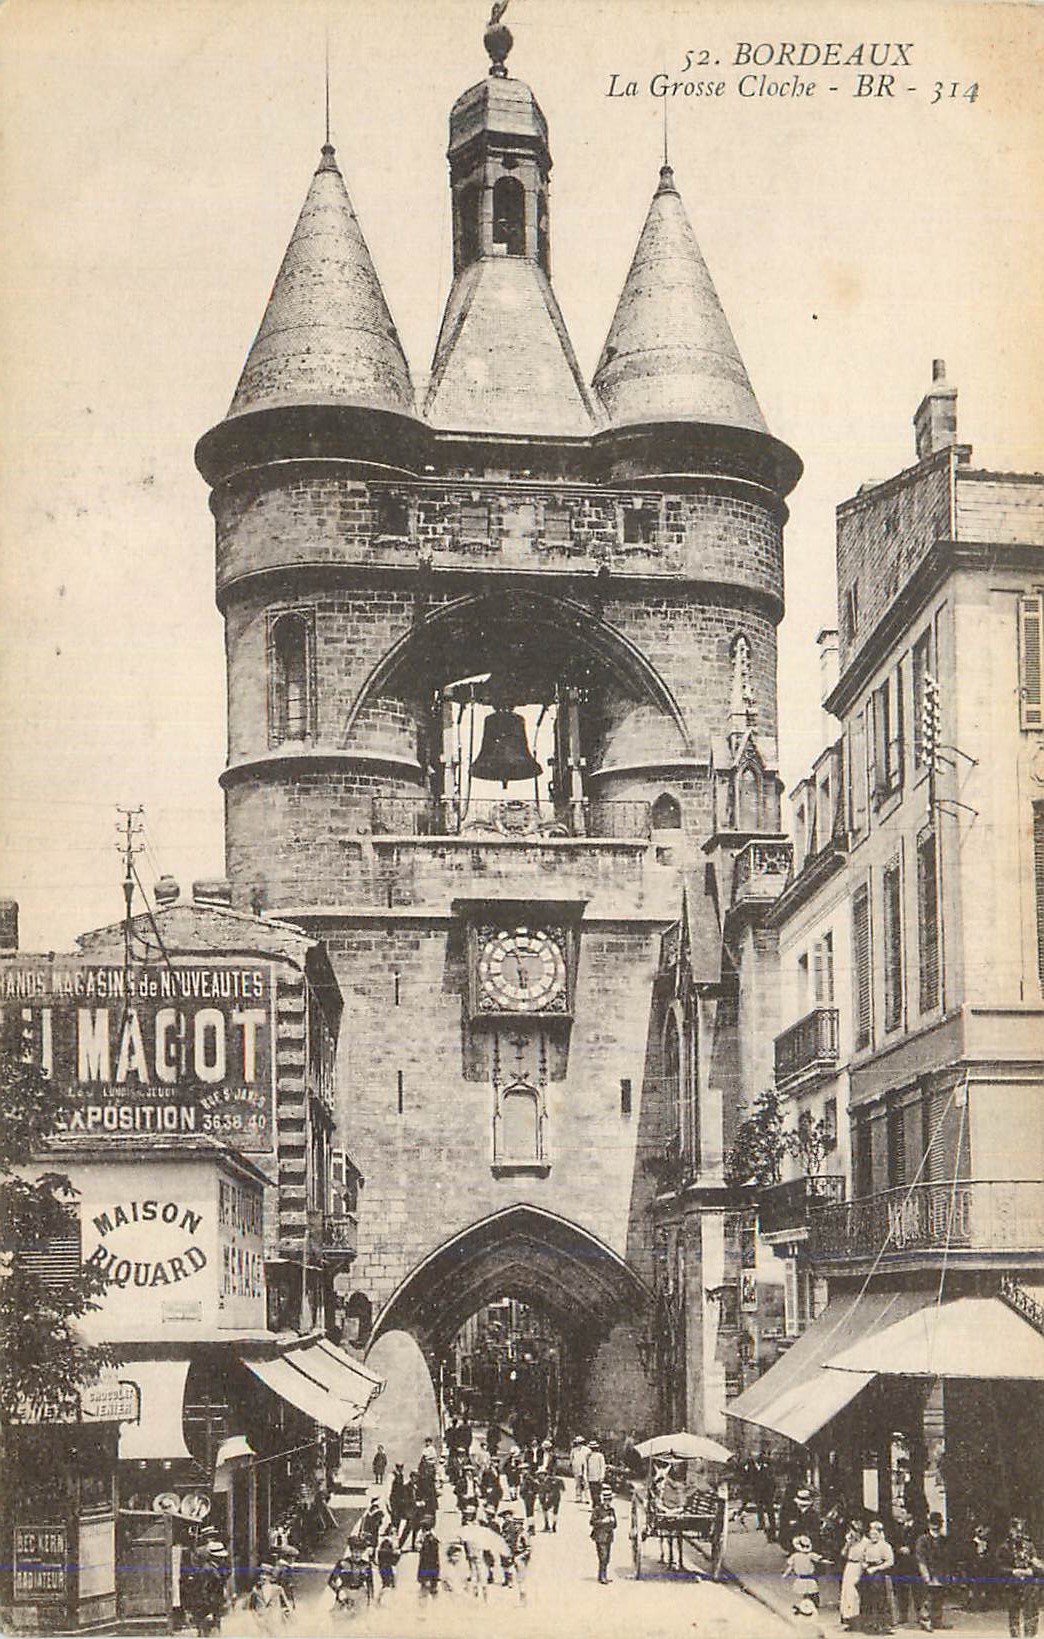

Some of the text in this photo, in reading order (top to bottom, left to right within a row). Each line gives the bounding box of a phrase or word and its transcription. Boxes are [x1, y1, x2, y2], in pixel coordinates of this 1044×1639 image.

[139, 973, 158, 997] de
[77, 1007, 267, 1084] MAGOT
[92, 1200, 203, 1237] MAISON
